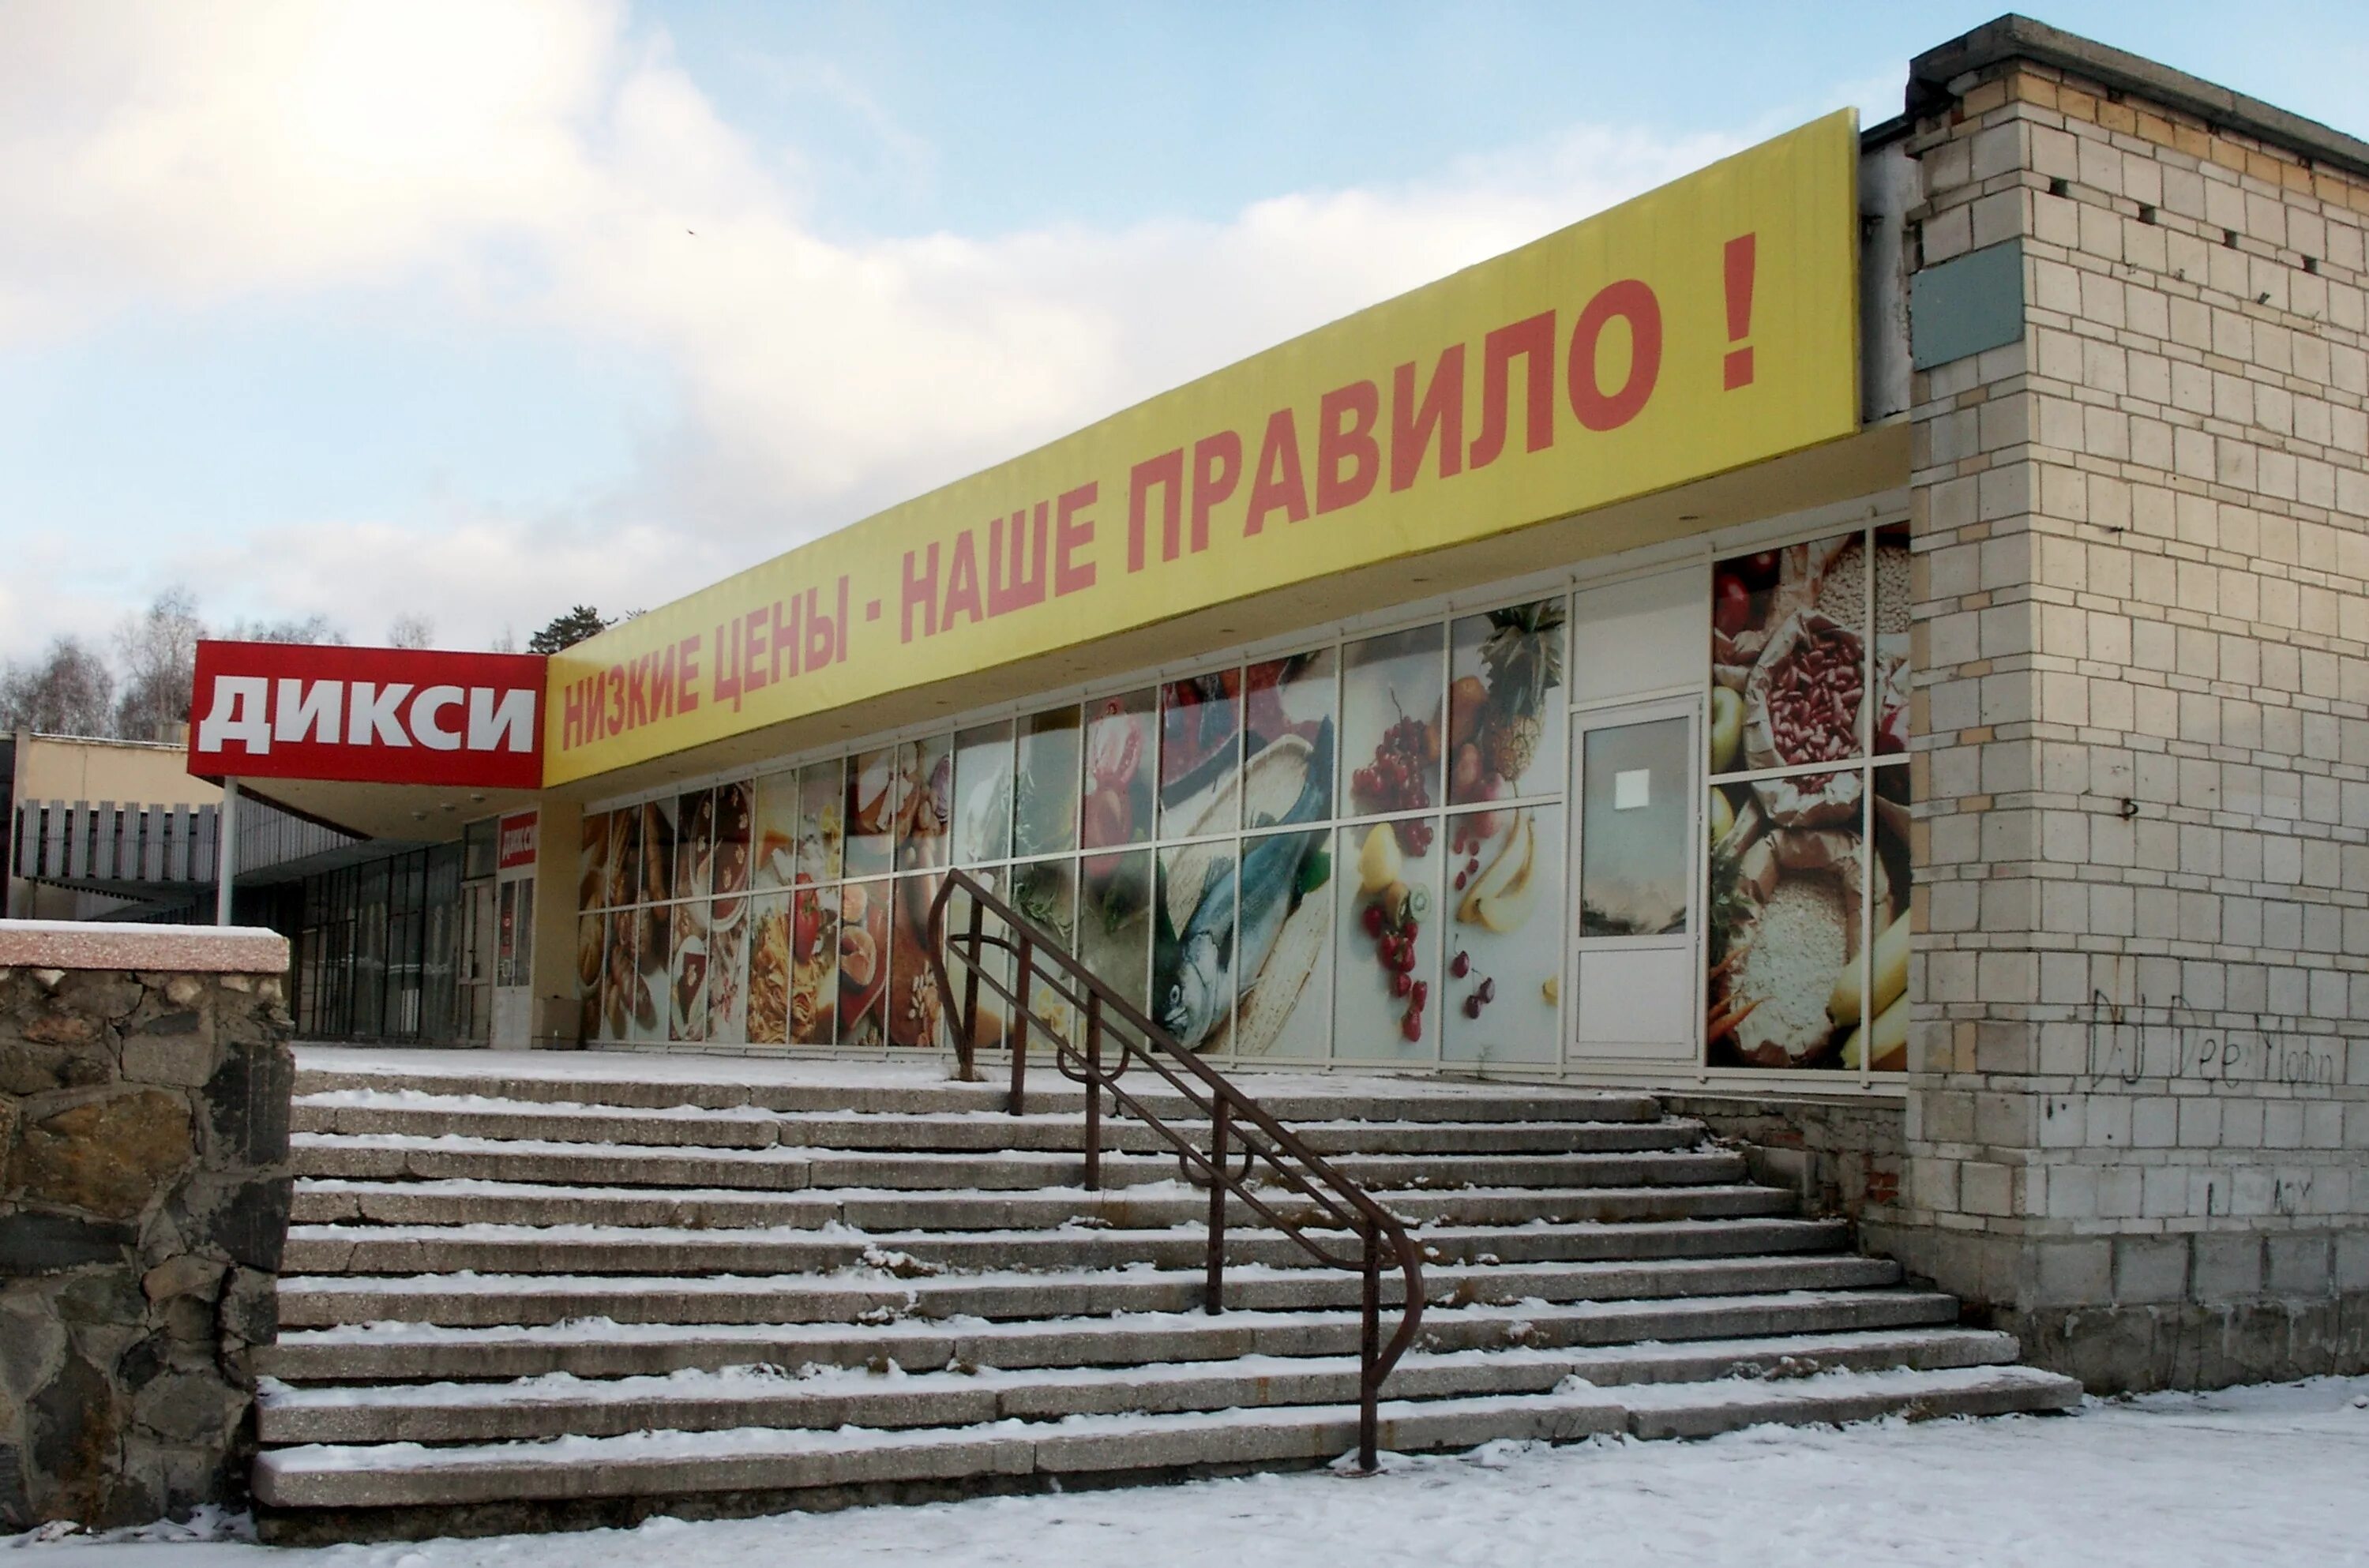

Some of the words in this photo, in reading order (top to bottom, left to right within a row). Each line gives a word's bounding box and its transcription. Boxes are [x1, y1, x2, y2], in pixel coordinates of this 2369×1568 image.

[562, 634, 701, 751] НИЗКИЕ
[713, 574, 850, 712] ЦЕНЫ
[865, 598, 880, 622] -
[900, 481, 1098, 643] НАШЕ
[1127, 279, 1663, 574] ПРАВИЛО
[198, 675, 536, 754] ДИКСИ
